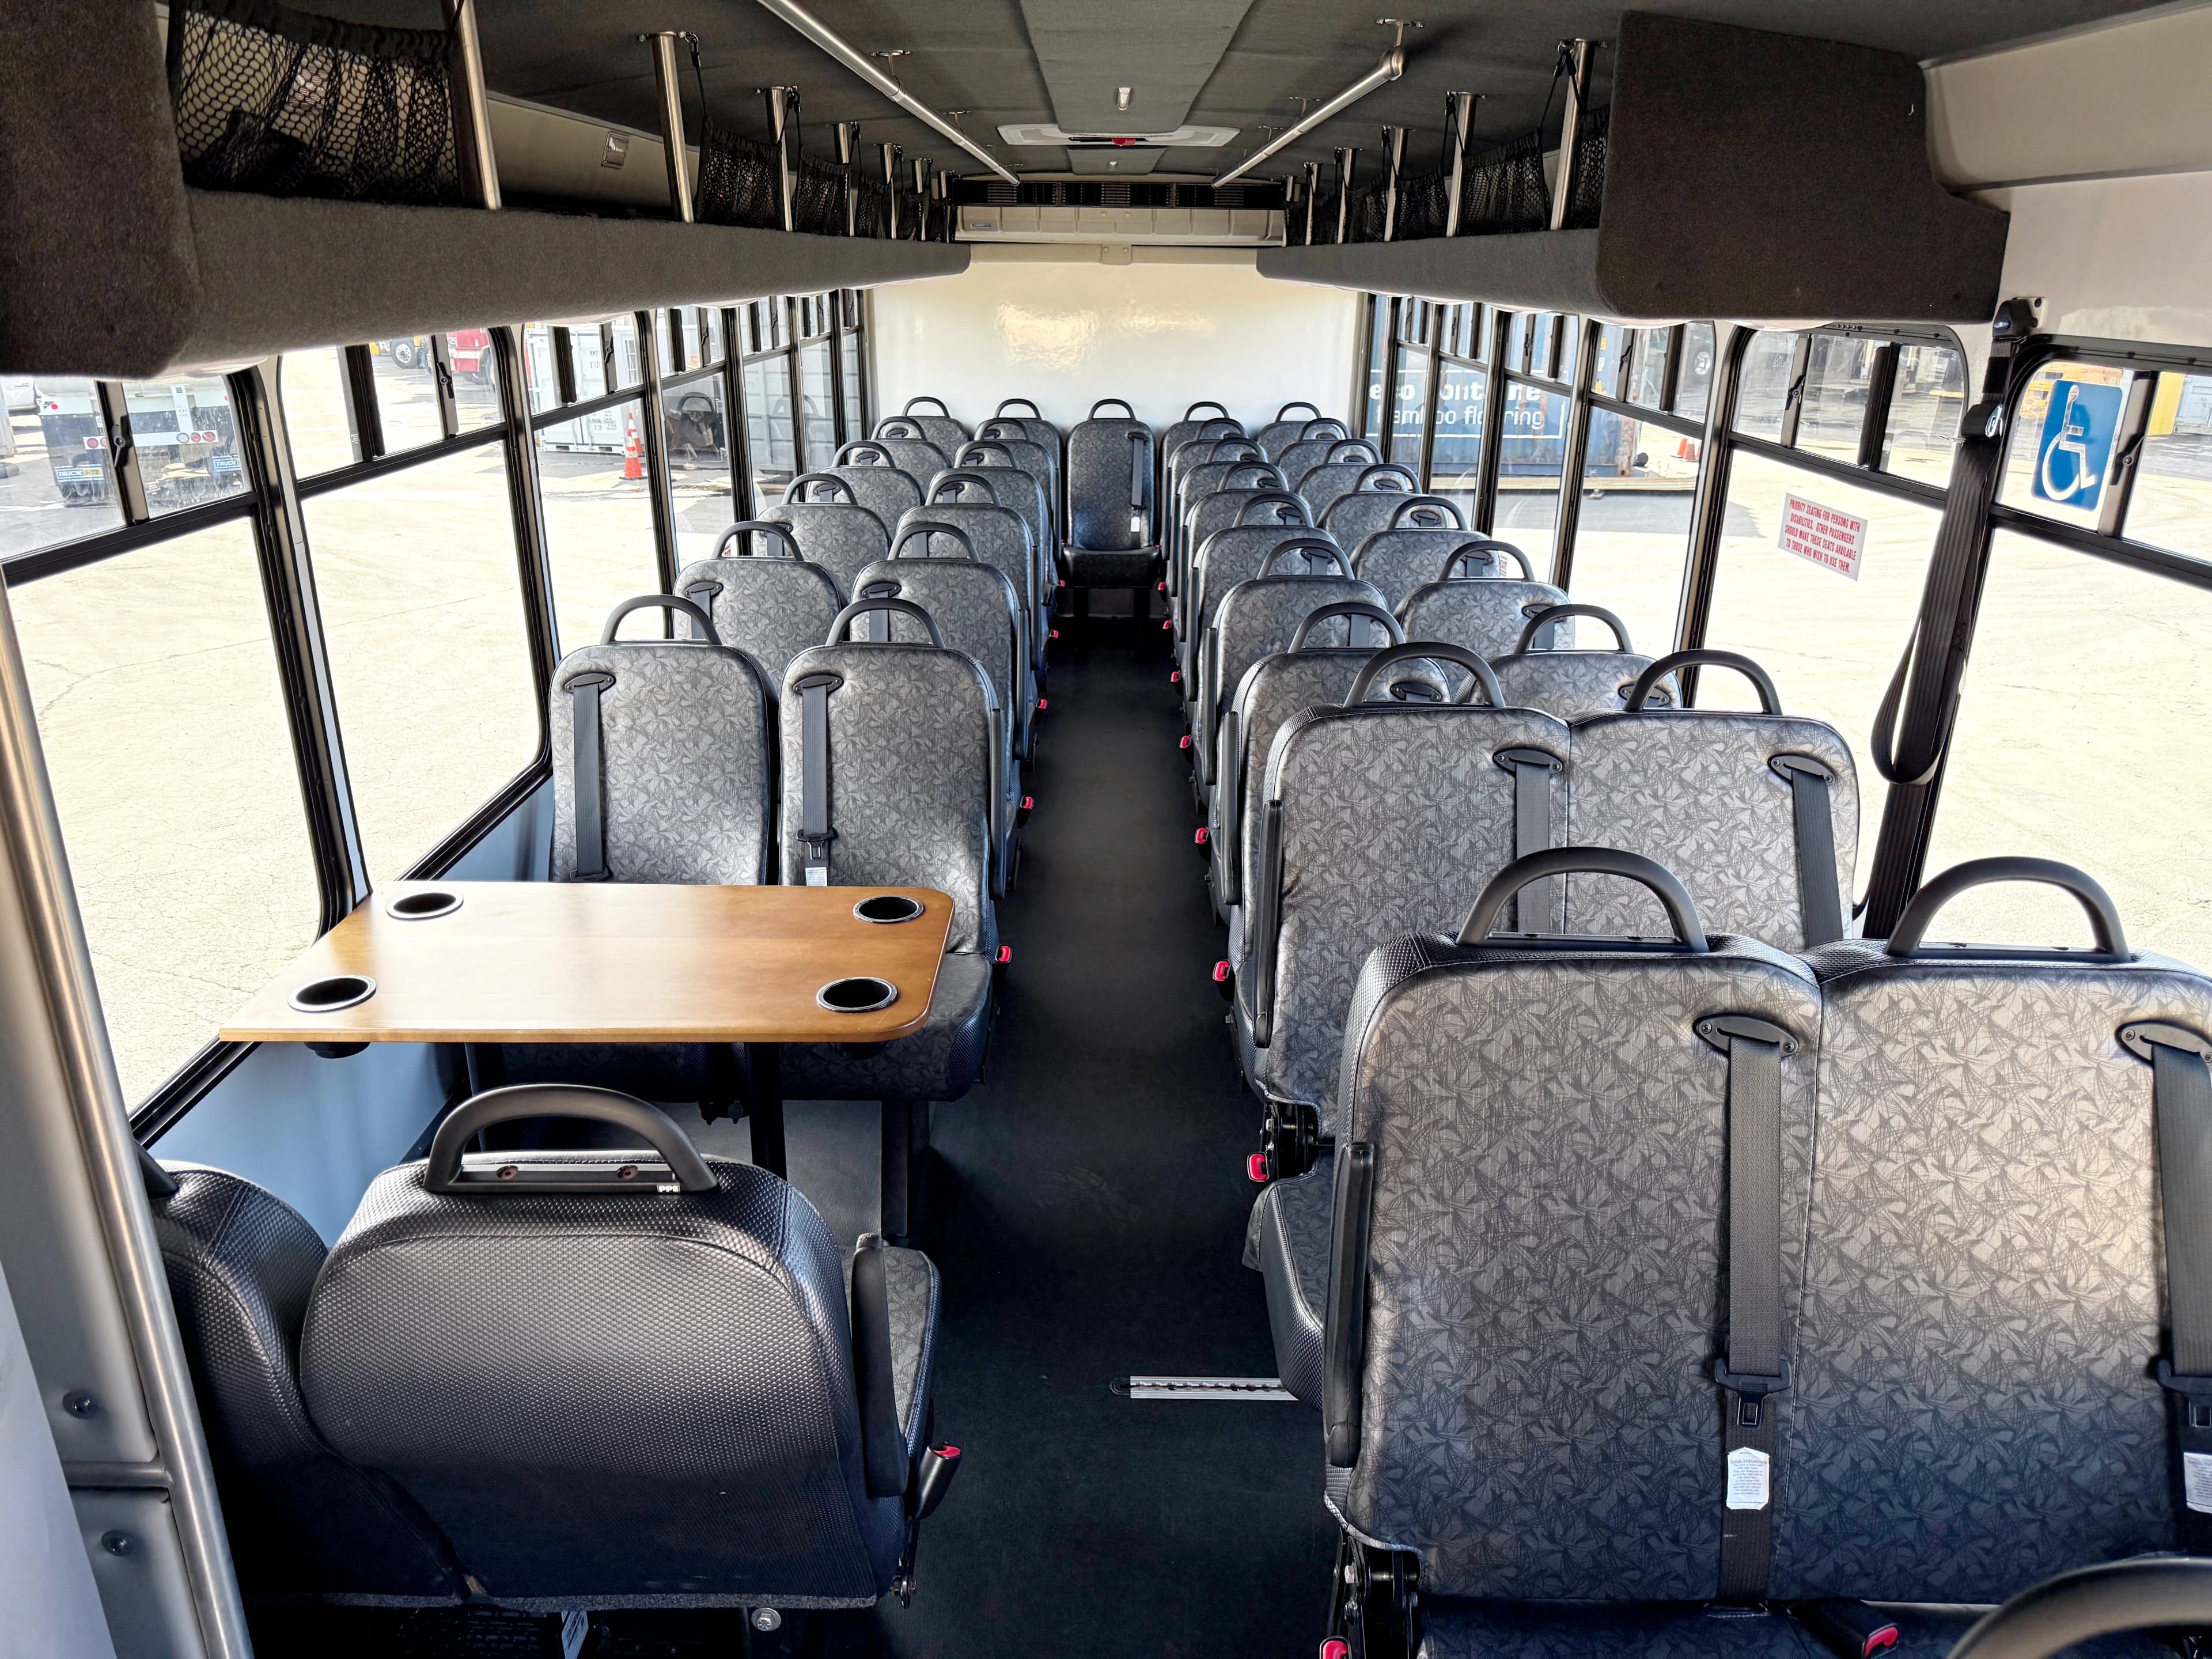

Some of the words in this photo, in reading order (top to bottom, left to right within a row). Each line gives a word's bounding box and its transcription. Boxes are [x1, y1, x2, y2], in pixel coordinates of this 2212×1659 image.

[1369, 384, 1415, 400] eo
[1464, 405, 1544, 430] floring
[1789, 499, 1806, 513] PRIORITY
[1806, 505, 1822, 518] SEATING
[1823, 510, 1831, 521] FOR
[1831, 513, 1849, 528] PERSONS
[1850, 520, 1861, 533] WITH
[1790, 513, 1813, 529] DISABILITIES.
[1816, 522, 1828, 536] OTHER
[1829, 527, 1855, 545] PASSENGERS
[1785, 524, 1798, 537] SHOULD
[1798, 529, 1809, 542] MAKE
[1810, 533, 1822, 547] THESE
[1822, 539, 1835, 552] SEATS
[1835, 544, 1857, 560] AVAILABLE
[1786, 537, 1791, 548] TO
[1791, 540, 1803, 553] THOSE
[1804, 545, 1812, 557] WHO
[1813, 548, 1823, 562] WISH
[1824, 554, 1829, 564] TO
[1829, 556, 1838, 567] USE
[1838, 559, 1850, 573] THEM.
